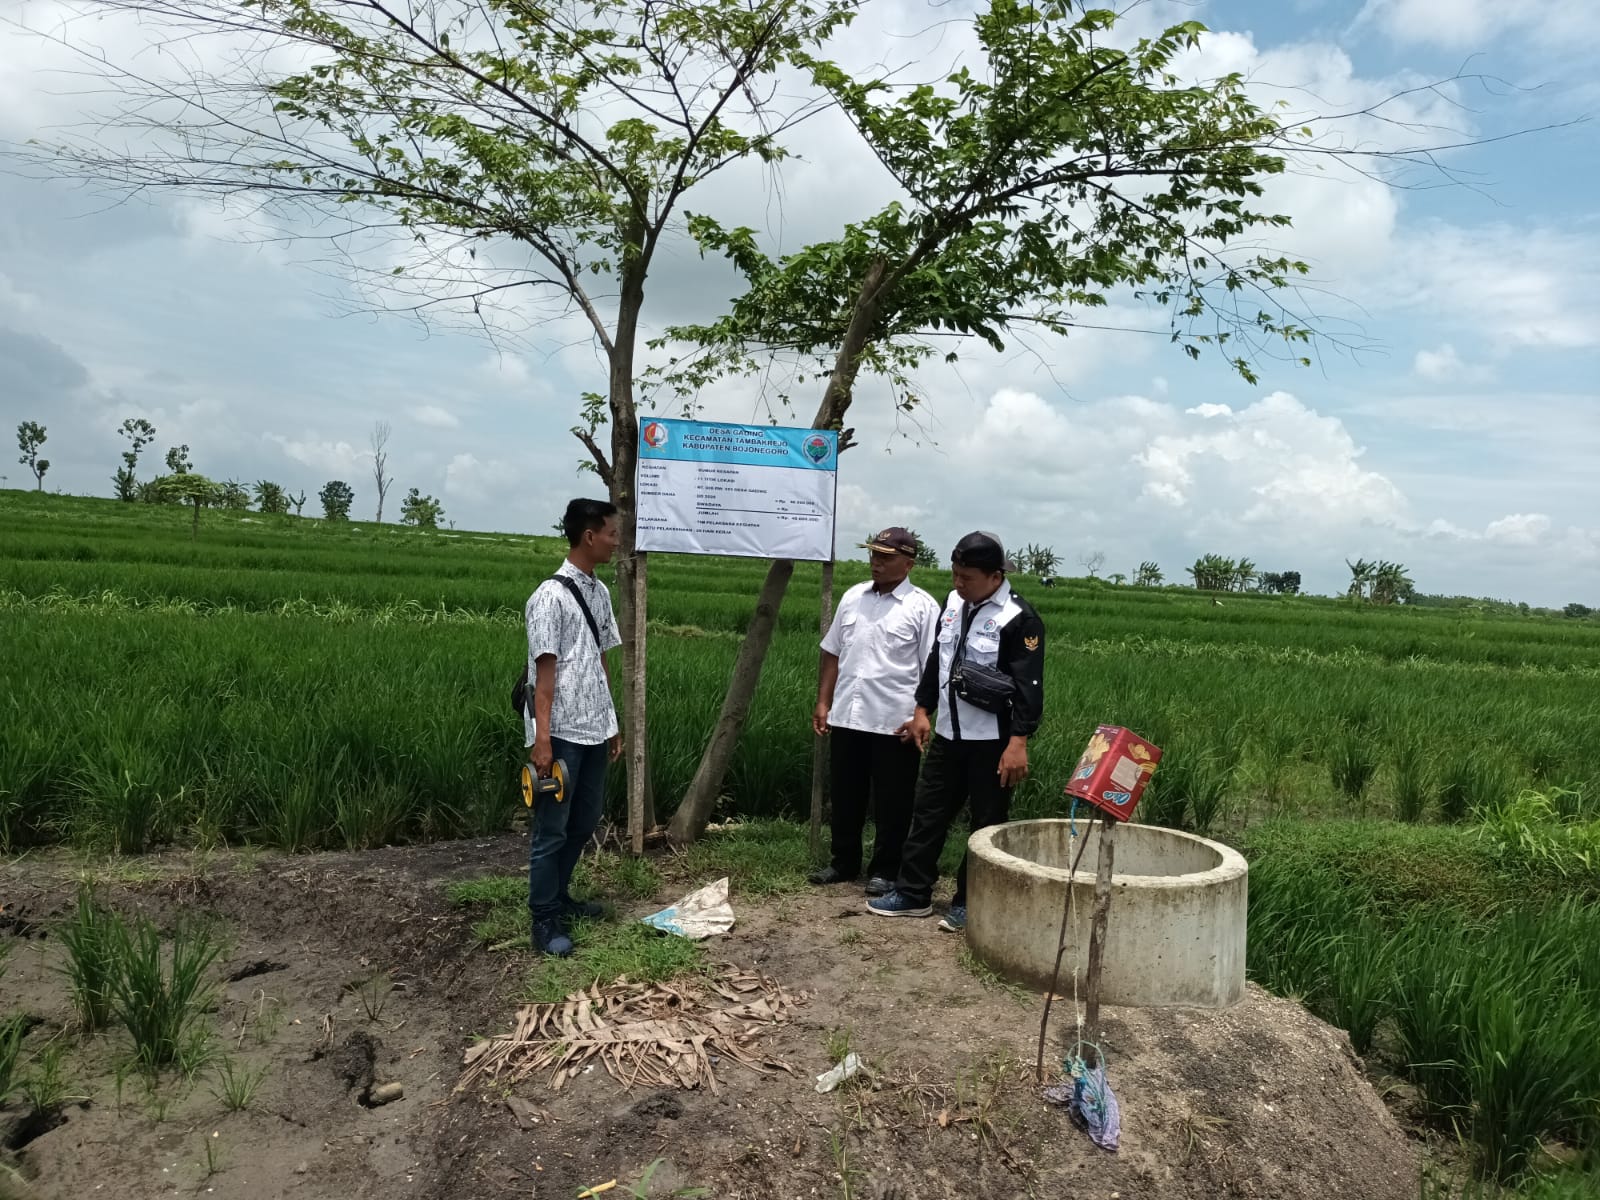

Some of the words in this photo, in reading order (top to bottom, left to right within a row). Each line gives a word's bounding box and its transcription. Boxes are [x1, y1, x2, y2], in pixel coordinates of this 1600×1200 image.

[683, 434, 733, 443] KECAMATAN
[735, 438, 788, 447] TAMBAKREJO
[682, 443, 731, 451] KABUPATEN
[732, 446, 789, 455] BOJONEGORO
